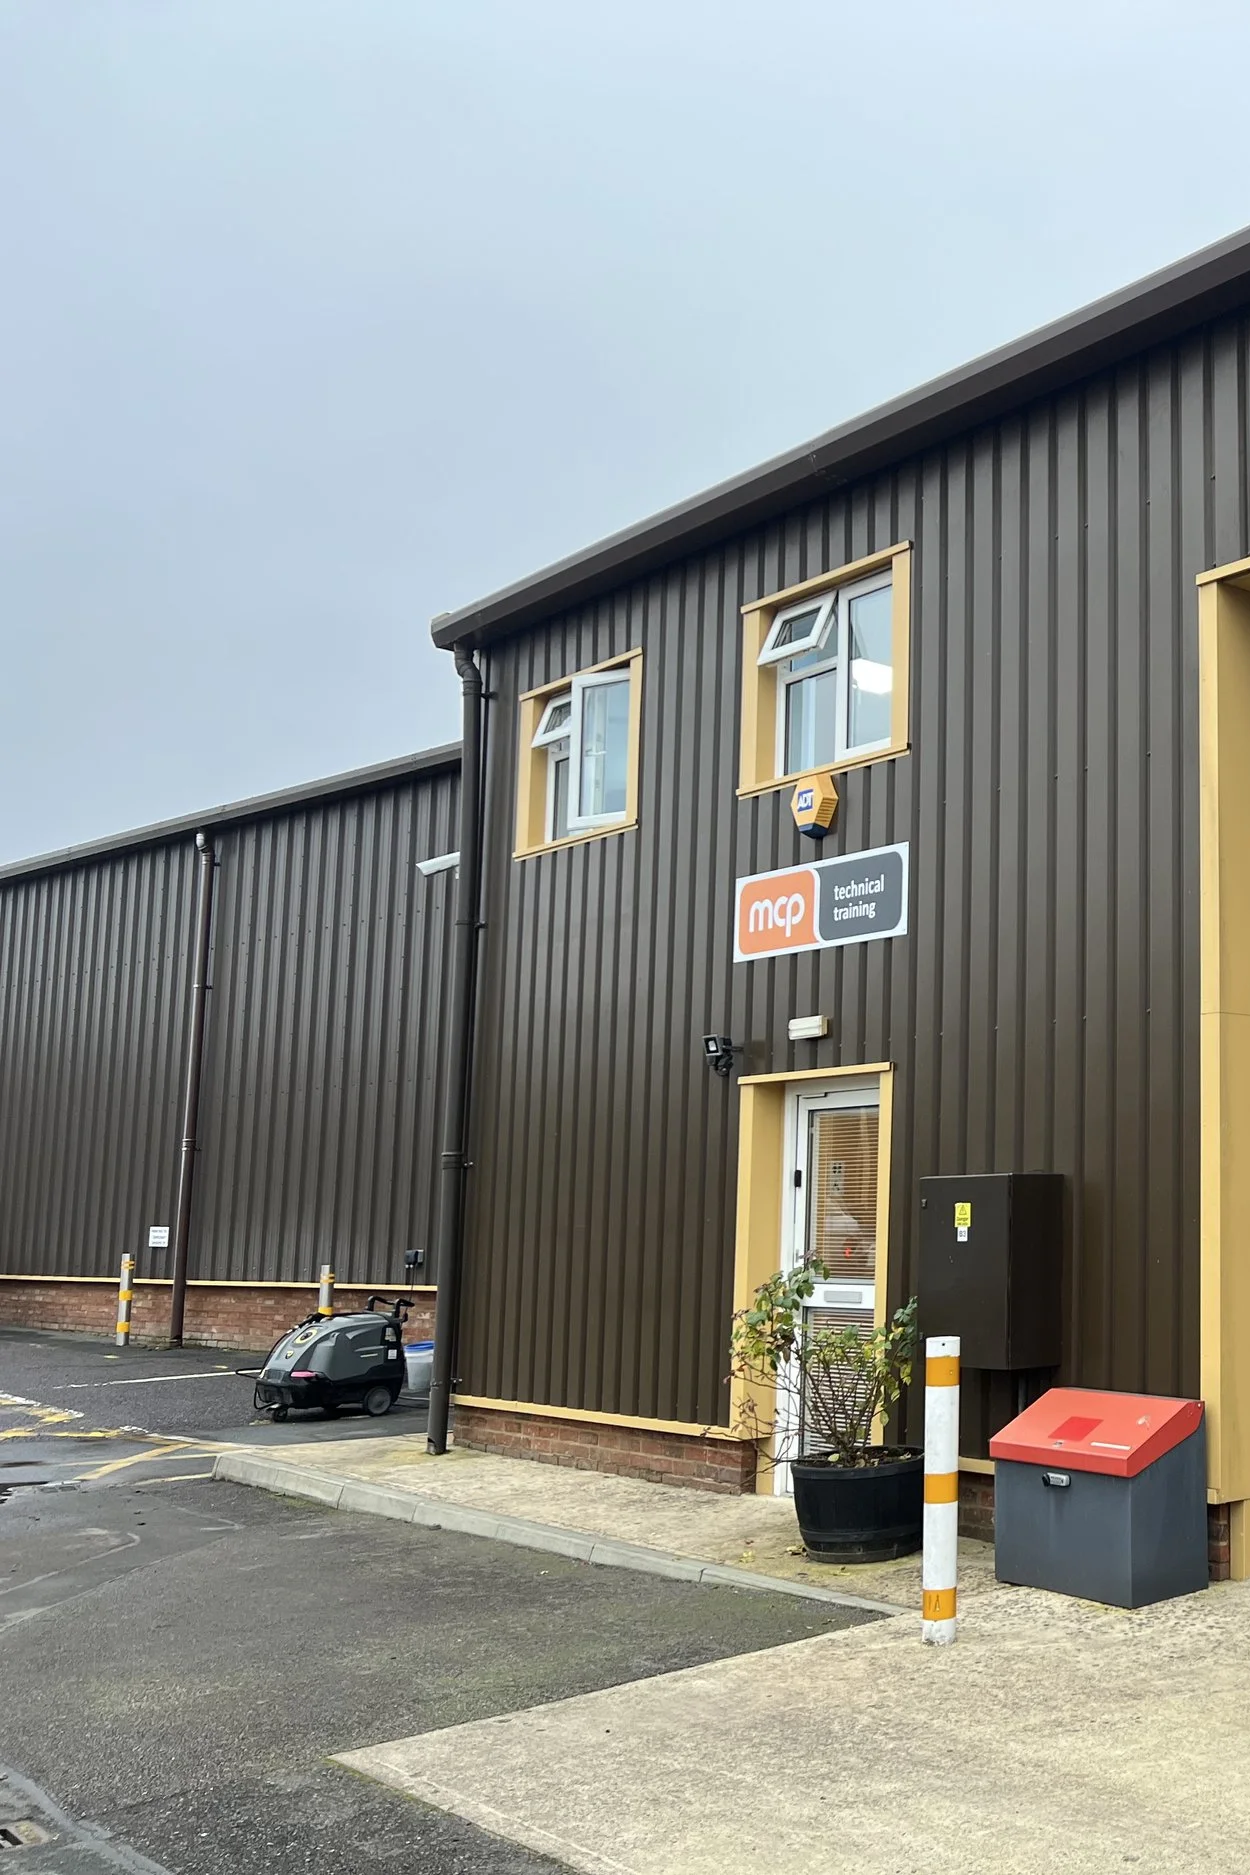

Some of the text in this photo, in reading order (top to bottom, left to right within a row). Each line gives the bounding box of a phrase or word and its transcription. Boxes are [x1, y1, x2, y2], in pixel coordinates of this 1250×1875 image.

[797, 791, 814, 809] ADT
[833, 874, 885, 900] technical
[749, 893, 805, 937] mcp
[833, 901, 876, 921] training
